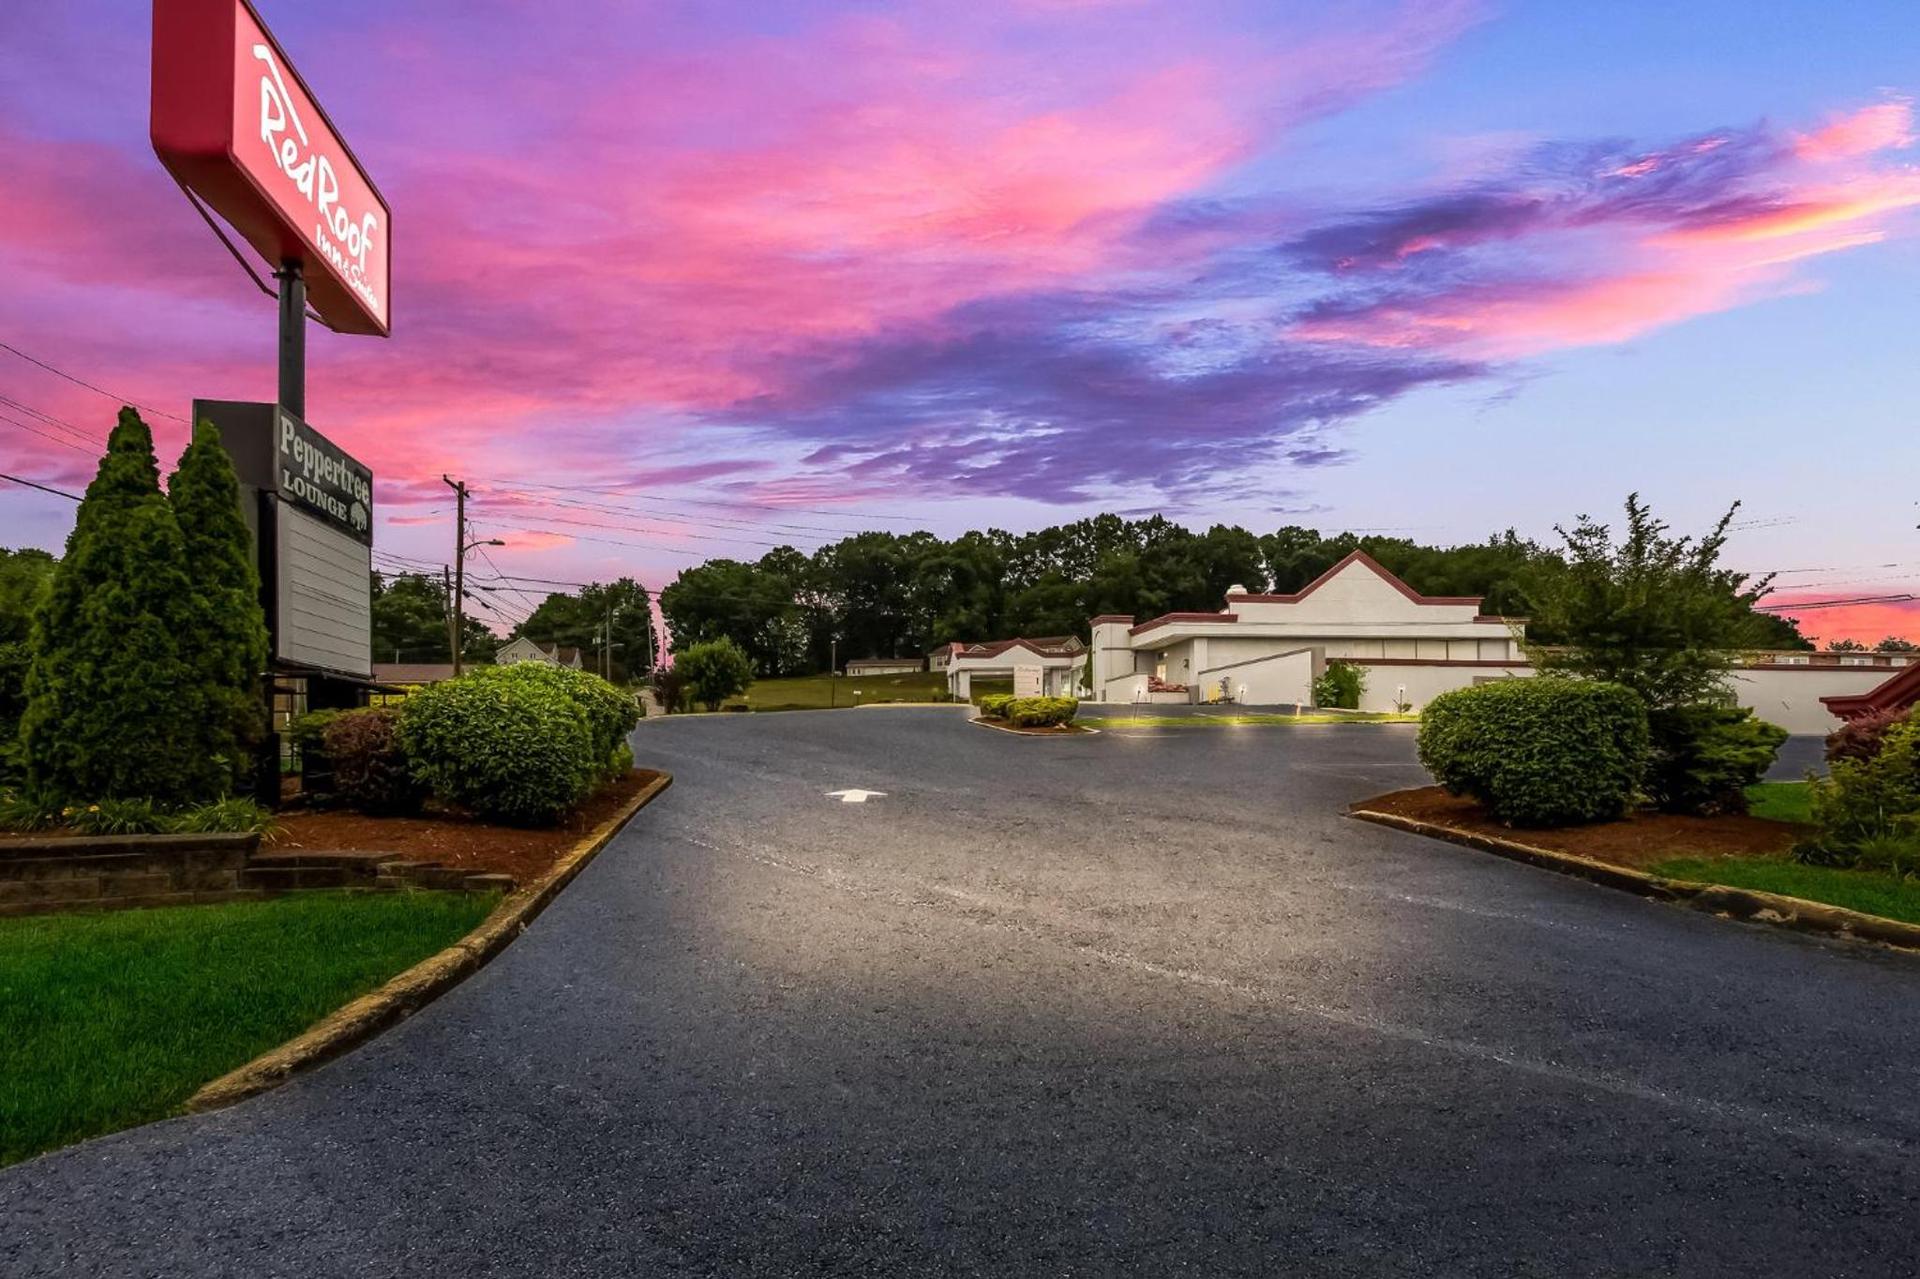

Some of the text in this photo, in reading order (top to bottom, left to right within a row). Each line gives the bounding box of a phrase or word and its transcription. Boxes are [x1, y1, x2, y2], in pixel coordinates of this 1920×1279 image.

[260, 75, 378, 273] Red Roof
[316, 223, 343, 270] Inn
[280, 415, 369, 505] Peppertree
[283, 468, 348, 523] LOUNGE
